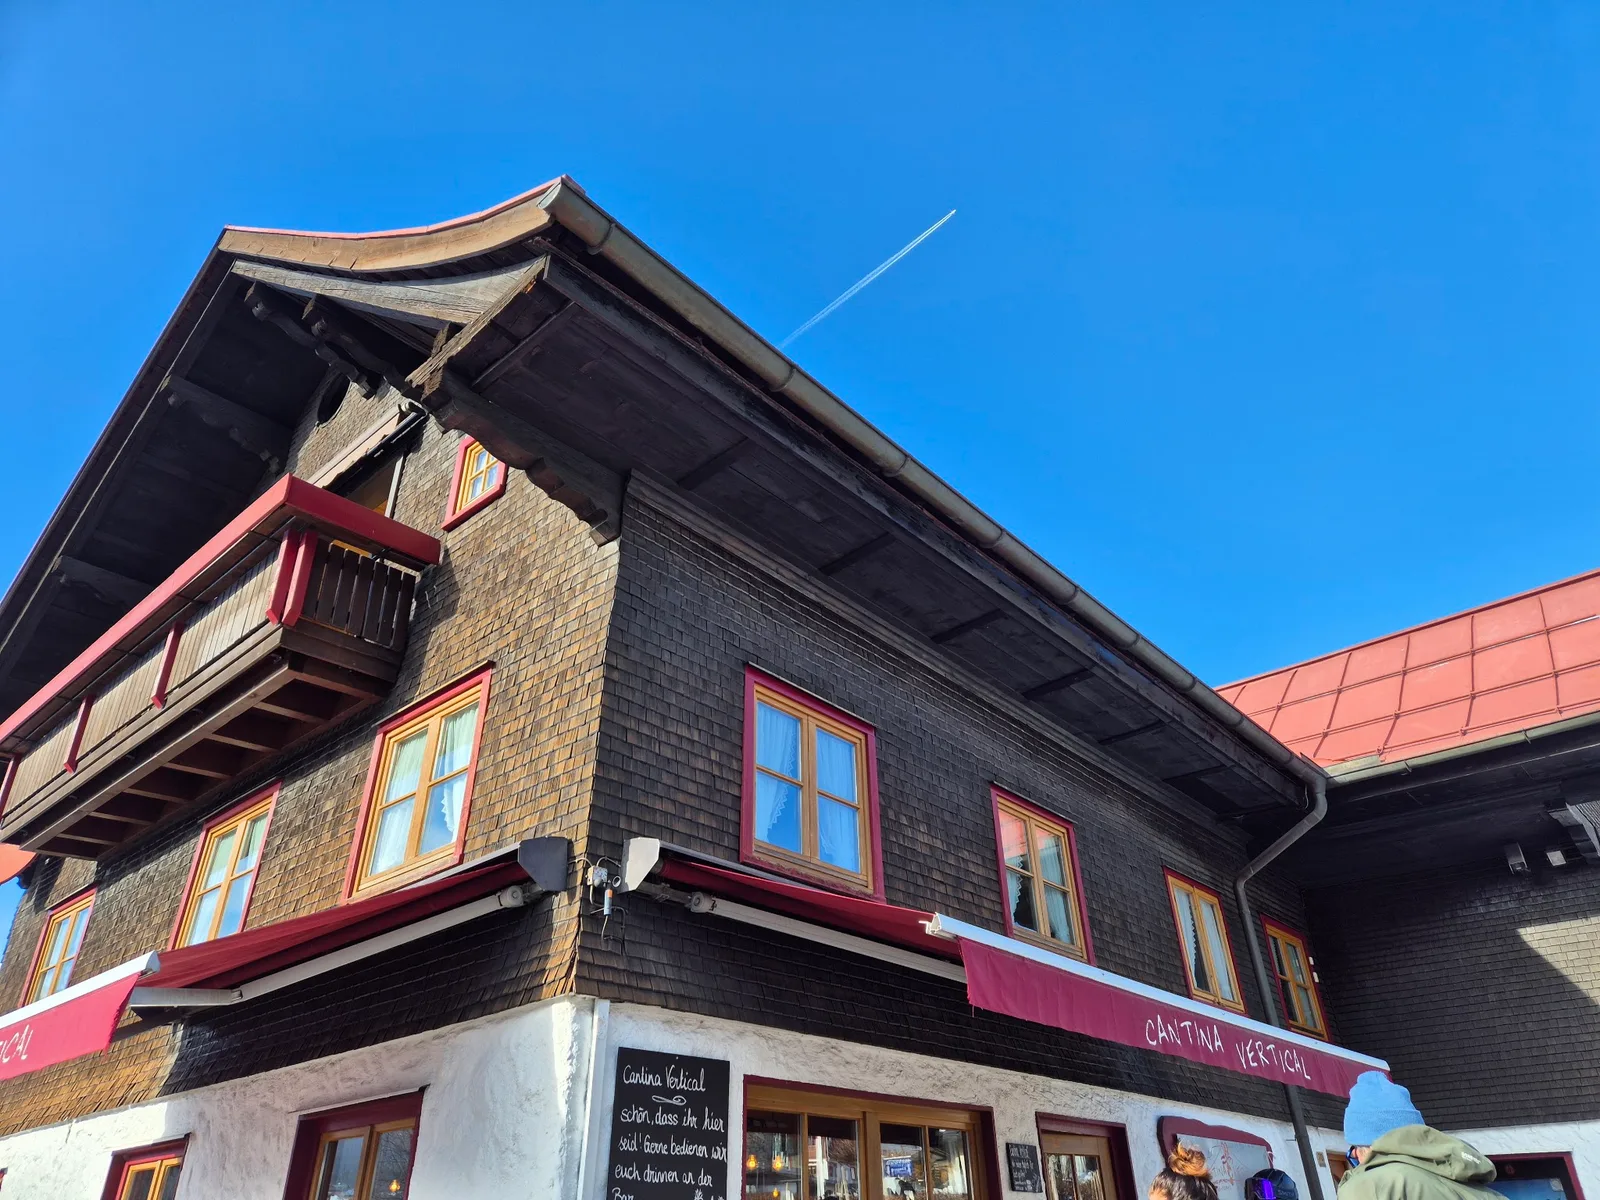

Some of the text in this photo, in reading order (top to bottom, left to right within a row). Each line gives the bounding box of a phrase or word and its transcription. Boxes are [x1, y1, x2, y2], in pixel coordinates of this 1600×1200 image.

[0, 1024, 34, 1063] ICAL
[1145, 1014, 1311, 1081] CANTINA VERTICAL
[622, 1064, 706, 1092] Cantina Vertical
[655, 1105, 679, 1126] dass
[682, 1107, 698, 1129] ihr
[702, 1106, 725, 1133] hier
[643, 1134, 669, 1154] Gerne
[670, 1134, 709, 1159] bedienen
[710, 1141, 727, 1163] wir
[614, 1161, 713, 1188] euch drinnen an der
